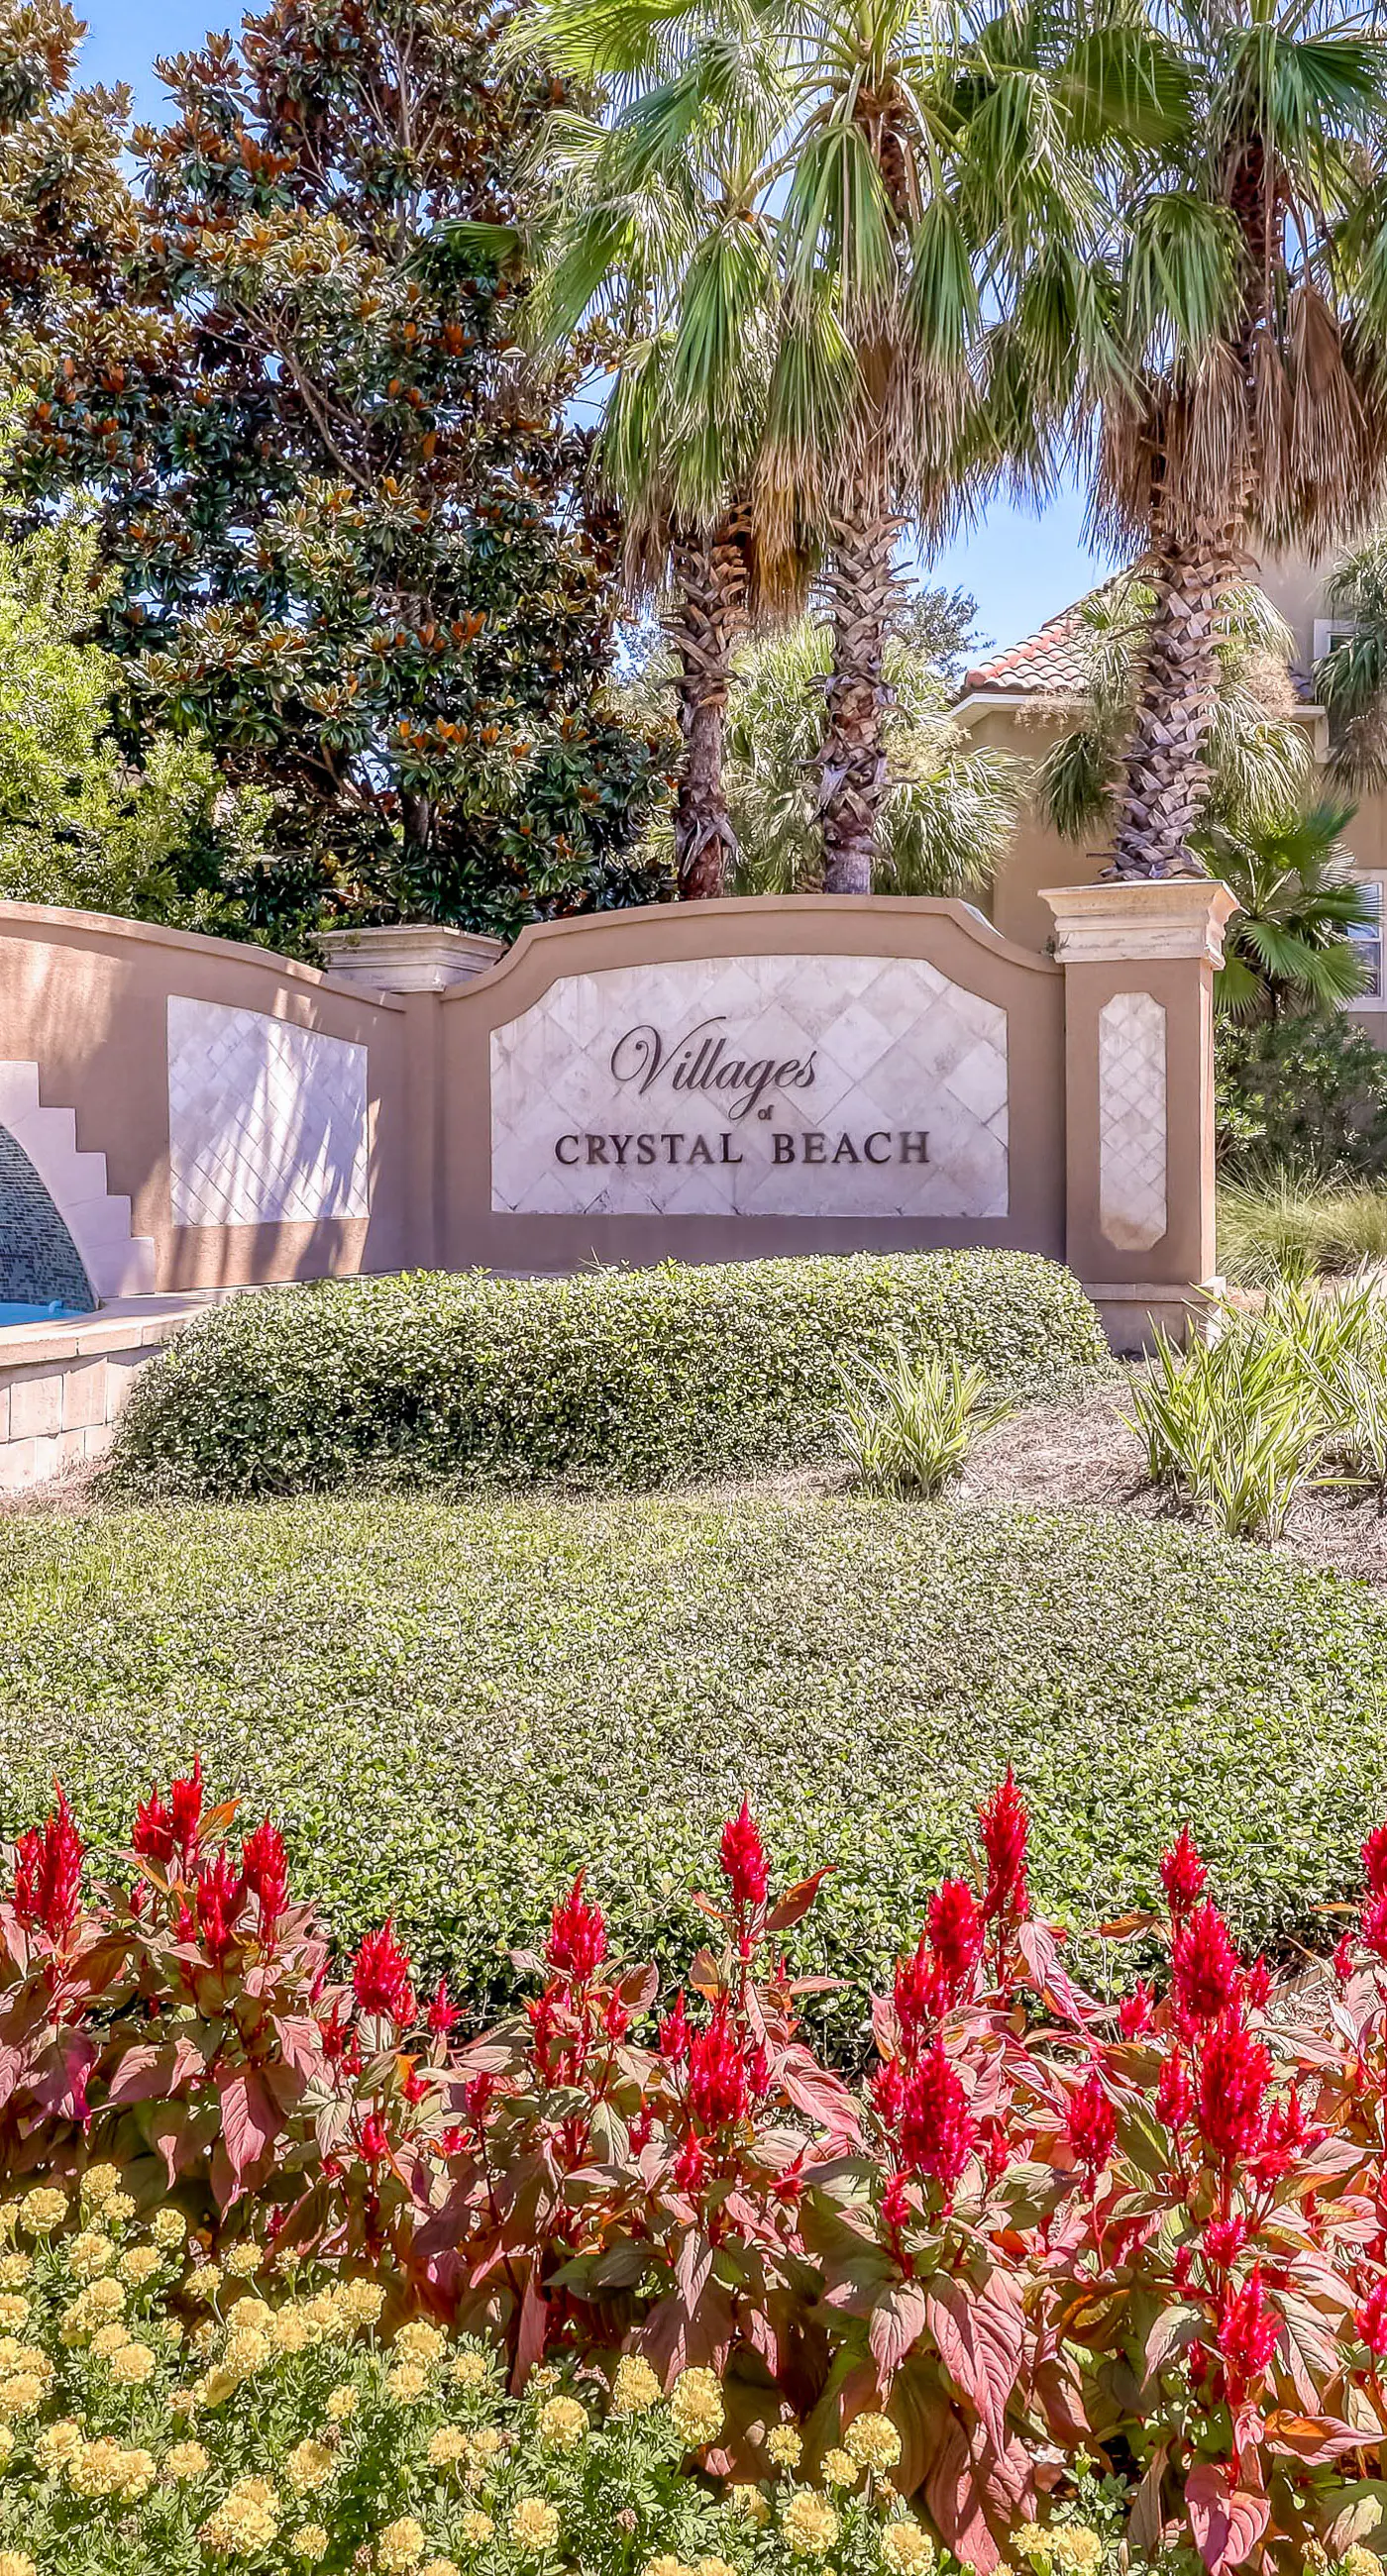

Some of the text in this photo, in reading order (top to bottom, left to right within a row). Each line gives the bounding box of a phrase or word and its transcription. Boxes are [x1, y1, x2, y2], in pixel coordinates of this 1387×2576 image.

[608, 1016, 818, 1121] Villages
[757, 1103, 776, 1121] of
[554, 1131, 931, 1165] CRYSTAL BEACH
